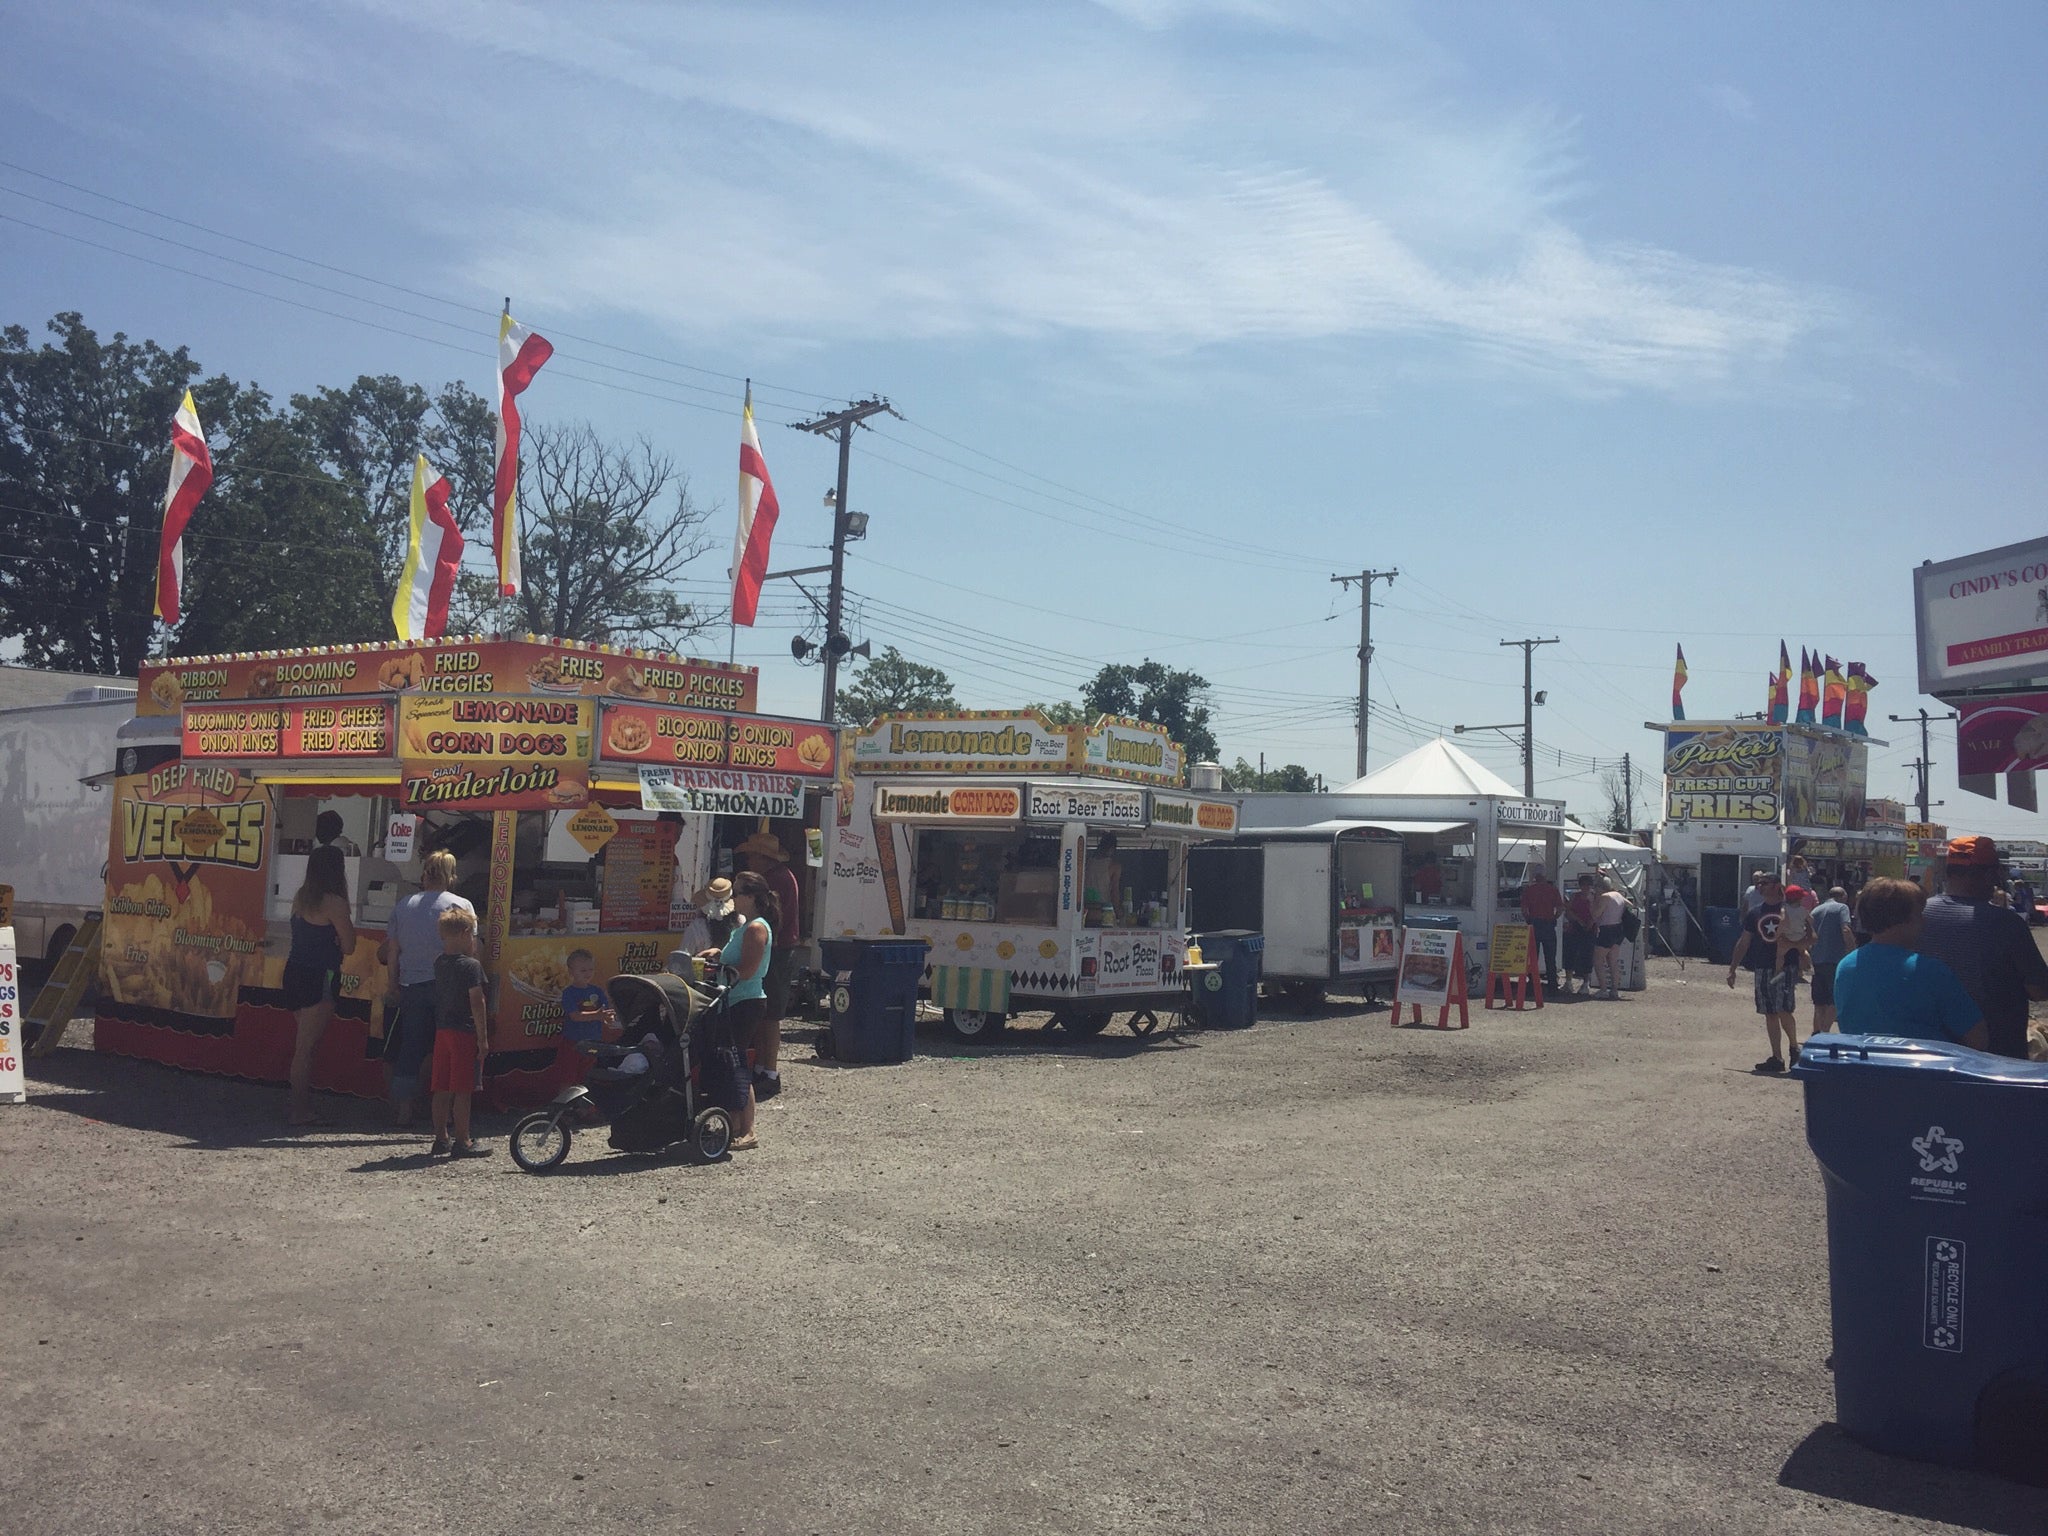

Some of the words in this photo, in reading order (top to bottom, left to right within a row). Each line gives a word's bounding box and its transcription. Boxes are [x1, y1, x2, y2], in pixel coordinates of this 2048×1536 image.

[1949, 569, 2018, 600] CINDY'S
[1970, 640, 2012, 658] FAMILY
[276, 660, 357, 683] BLOOMING
[434, 652, 481, 673] FRIED
[560, 655, 604, 680] FRIES
[180, 670, 228, 688] RIBBON
[289, 683, 342, 697] ONION
[420, 673, 493, 693] VEGGIES
[643, 667, 686, 690] FRIED
[689, 673, 745, 698] PICKLES
[452, 700, 579, 724] LEMONADE
[683, 693, 737, 711] CHEESE
[187, 712, 247, 731] BLOOMING
[249, 710, 291, 730] ONION
[303, 708, 336, 728] FRIED
[339, 705, 386, 728] CHEESE
[200, 734, 239, 752] ONION
[241, 732, 278, 752] RINGS
[301, 731, 334, 752] FRIED
[337, 730, 386, 751] PICKLES
[657, 716, 740, 743] BLOOMING
[743, 725, 793, 748] ONION
[889, 723, 1032, 756] Lemonade
[426, 731, 494, 755] CORN
[499, 732, 568, 757] DOGS
[673, 740, 730, 764] ONION
[733, 747, 777, 767] RINGS
[1106, 730, 1163, 768] Lemonade
[1668, 731, 1782, 774] Parker's
[151, 764, 188, 797] DEEP
[192, 766, 236, 797] FRIED
[431, 763, 464, 779] GIANT
[641, 768, 671, 778] FRESH
[672, 768, 744, 791] FRENCH
[746, 773, 796, 796] FRIES
[405, 762, 560, 806] Tenderloin
[647, 778, 667, 787] CUT
[1673, 778, 1730, 792] FRESH
[1733, 778, 1772, 792] CUT
[689, 790, 797, 817] LEMONADE
[881, 788, 949, 814] Lemonade
[953, 791, 984, 812] CORN
[986, 791, 1015, 813] DOGS
[1032, 797, 1061, 817] Root
[1068, 798, 1097, 817] Beer
[1102, 800, 1141, 818] Floats
[1670, 793, 1778, 820] FRIES
[1152, 801, 1194, 826] Lemonade
[1496, 805, 1522, 819] SCOUT
[1524, 807, 1549, 821] TROOP
[1549, 810, 1562, 823] 316
[178, 828, 224, 836] LEMONADE
[390, 821, 413, 838] Coke
[571, 823, 613, 833] LEMONADE
[833, 861, 855, 878] Root
[856, 861, 879, 878] Beer
[490, 810, 511, 961] LEMONADE
[110, 896, 143, 915] Ribbon
[144, 899, 172, 921] Chips
[175, 928, 222, 953] Blooming
[224, 933, 257, 954] Onion
[625, 942, 658, 957] Fried
[1411, 946, 1445, 955] Sandwich
[1423, 939, 1447, 948] Cream
[126, 945, 148, 963] Fries
[618, 956, 663, 974] Veggies
[1103, 950, 1130, 974] Root
[1131, 942, 1157, 967] Beer
[521, 1003, 564, 1020] Ribbo
[524, 1019, 563, 1038] Chips
[1911, 1177, 1967, 1191] REPUBLIC
[1946, 1261, 1960, 1304] RECYCLE
[1945, 1305, 1959, 1331] ONLY
